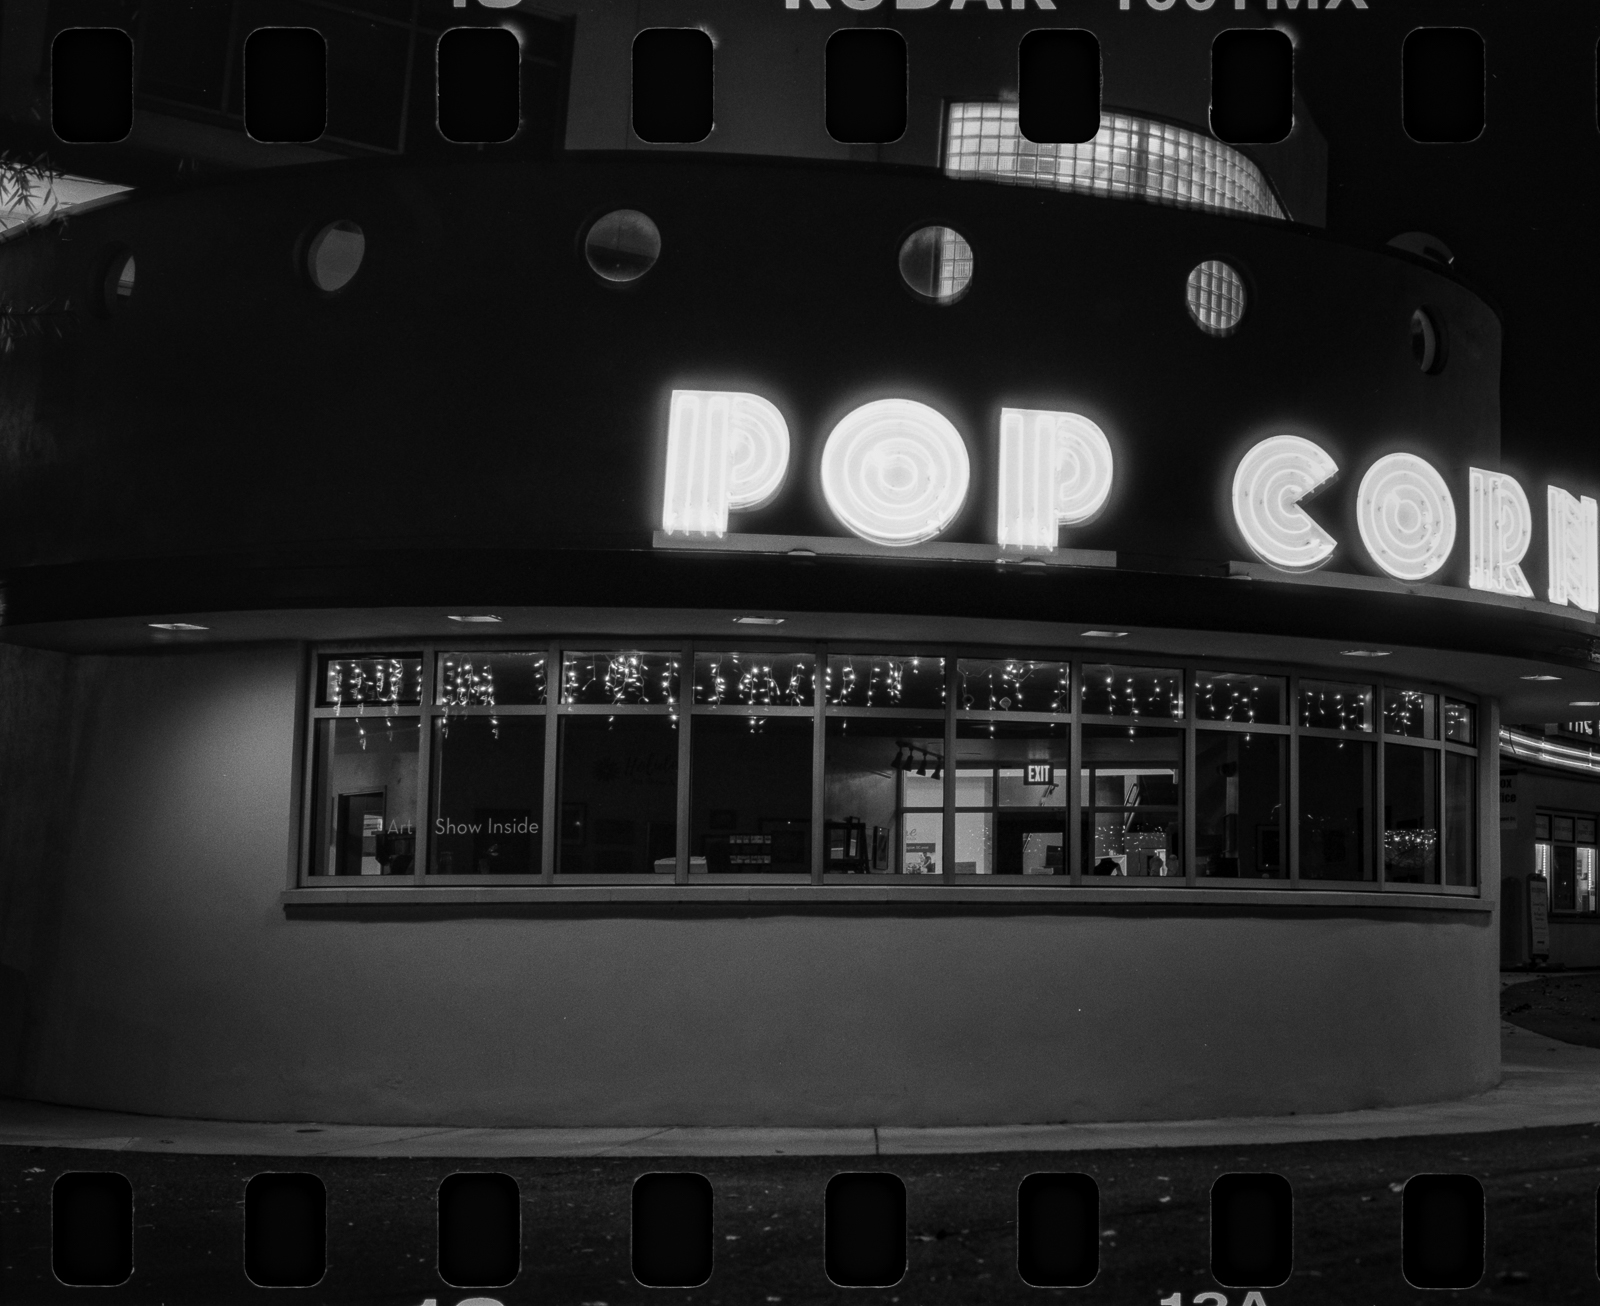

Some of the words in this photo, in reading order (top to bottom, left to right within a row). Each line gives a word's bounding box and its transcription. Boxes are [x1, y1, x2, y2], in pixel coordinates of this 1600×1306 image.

[663, 389, 1114, 550] POP
[1232, 434, 1599, 613] CORN
[1028, 765, 1051, 782] EXIT
[387, 819, 413, 835] Art
[435, 817, 483, 835] Show
[488, 816, 540, 834] Inside
